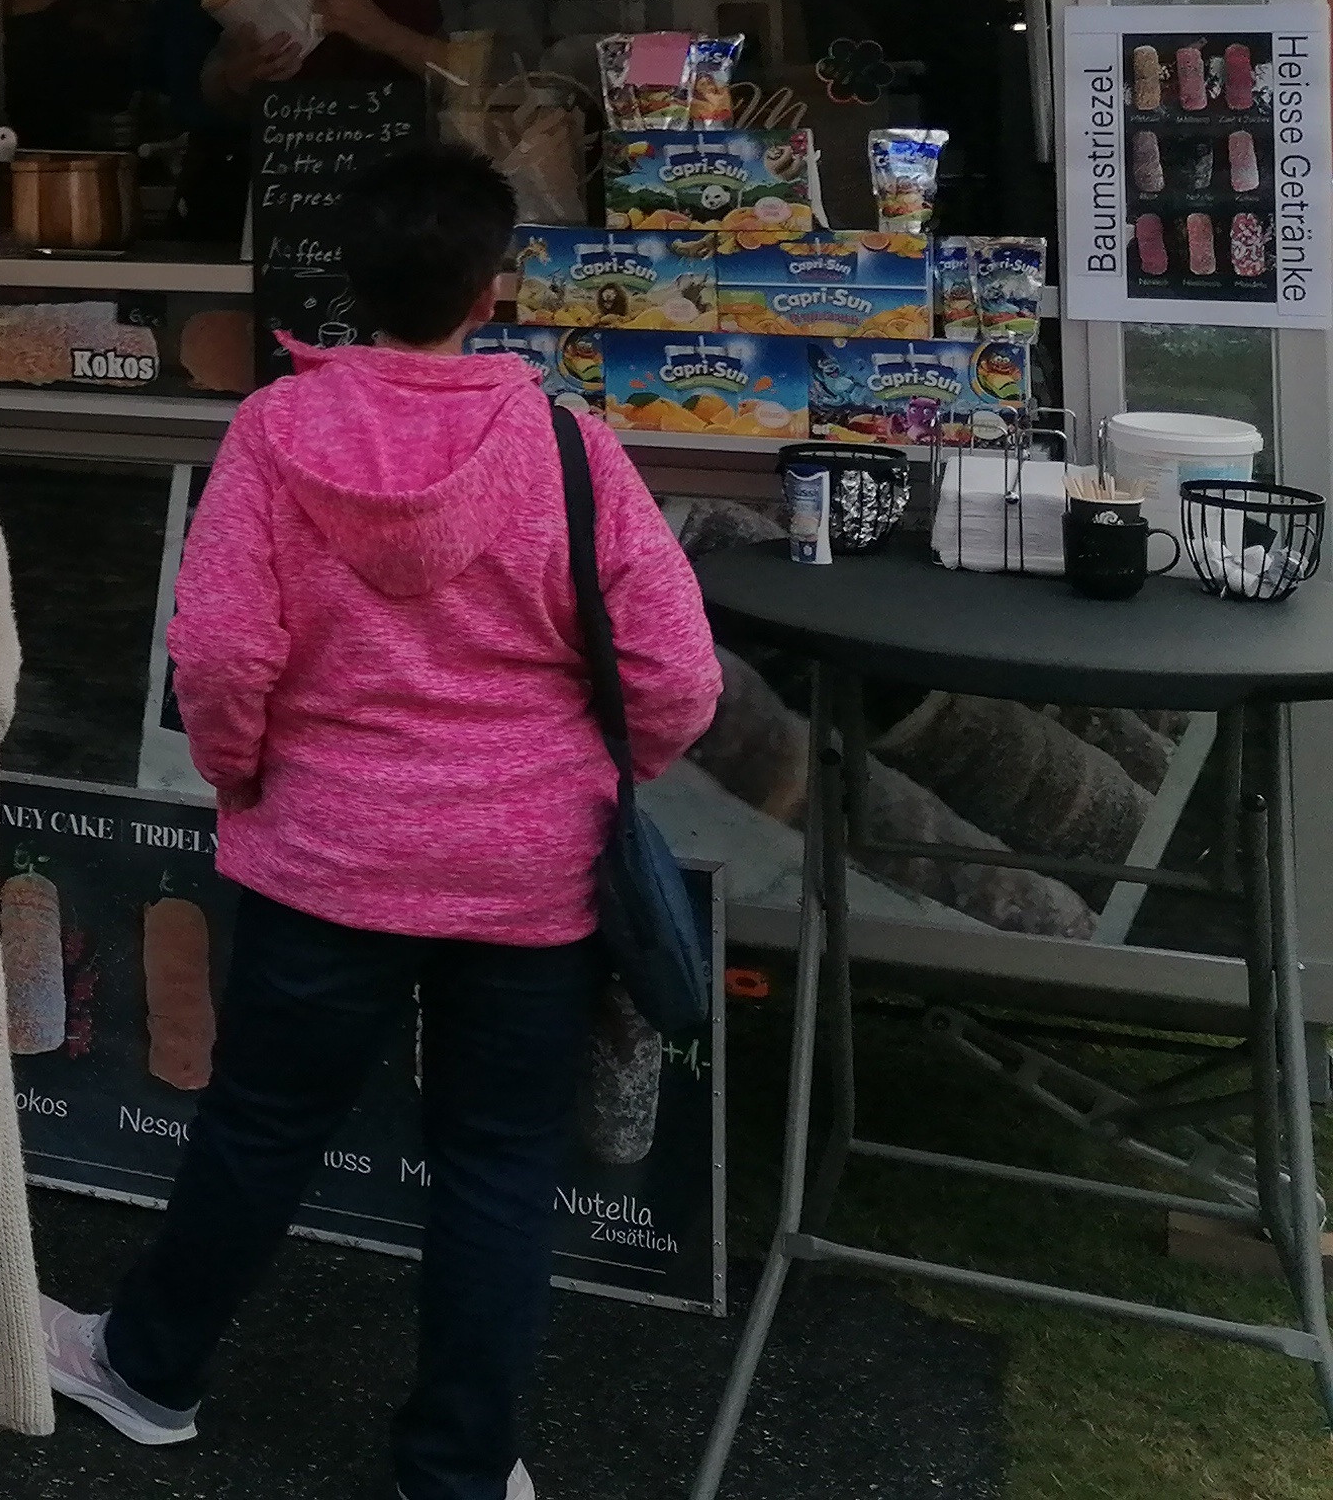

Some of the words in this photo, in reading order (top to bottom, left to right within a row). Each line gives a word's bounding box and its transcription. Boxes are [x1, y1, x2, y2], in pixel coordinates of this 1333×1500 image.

[1277, 36, 1310, 144] Heisse
[658, 159, 748, 183] Capri-Sun
[1083, 65, 1116, 274] Baumstriezel
[1280, 155, 1313, 302] Getränke
[570, 257, 658, 282] Capri-Sun
[789, 259, 852, 276] Capri-Sun
[773, 288, 873, 314] Capri-Sun
[71, 349, 155, 379] Kokos
[659, 359, 749, 386] Capri-Sun
[867, 369, 963, 397] Capri-Sun
[50, 811, 114, 840] CAKE
[15, 1087, 69, 1118] okos
[553, 1186, 654, 1227] Nutella
[590, 1220, 679, 1254] Zusätlich
